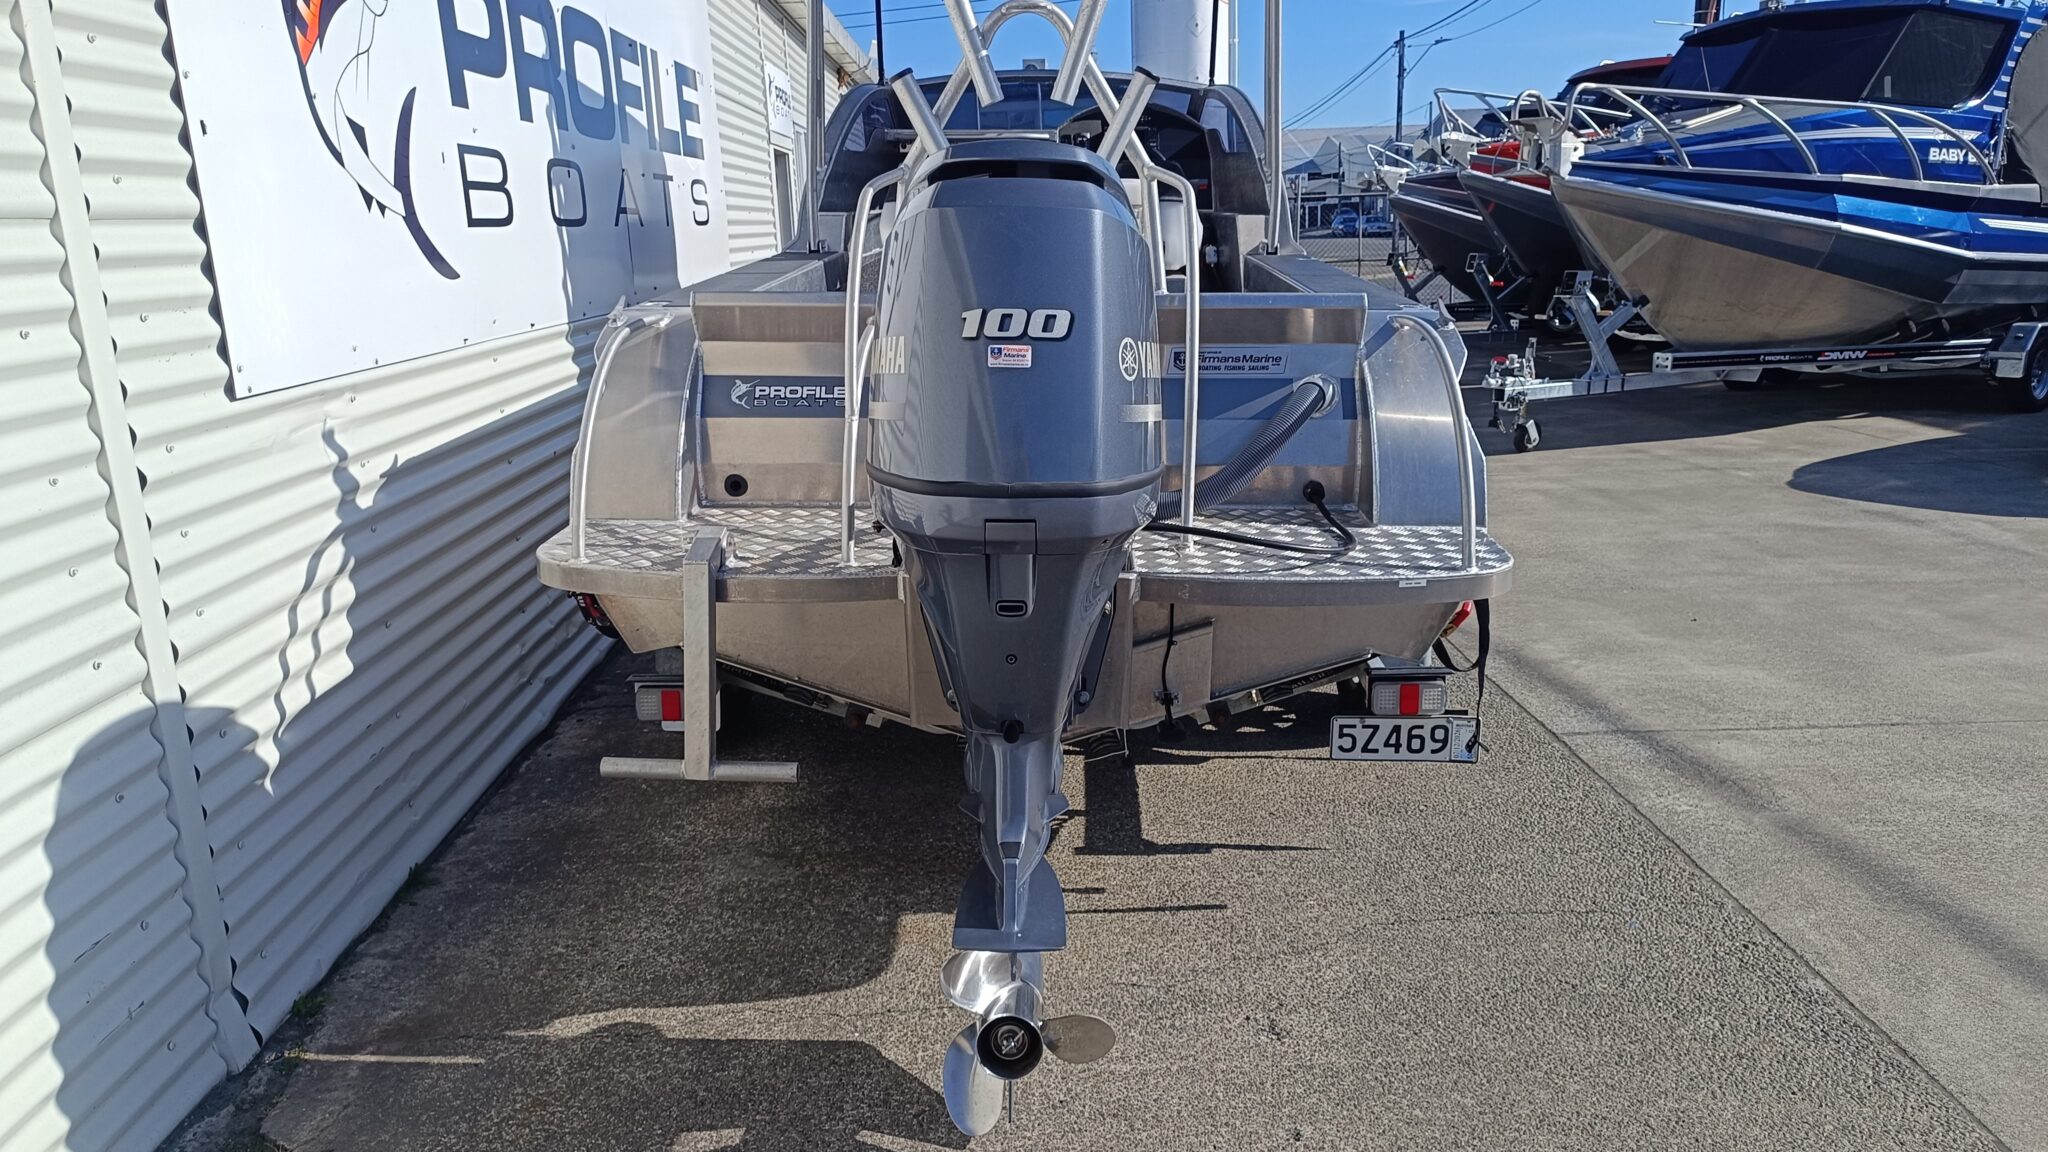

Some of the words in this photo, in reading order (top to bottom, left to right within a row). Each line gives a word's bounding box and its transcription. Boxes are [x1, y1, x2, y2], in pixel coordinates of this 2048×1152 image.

[437, 0, 705, 160] PROFILE
[1928, 147, 1966, 164] BABY
[457, 143, 710, 228] BOATS
[961, 308, 1072, 339] 100
[755, 386, 846, 398] PROFILE
[1337, 724, 1450, 754] 5Z469
